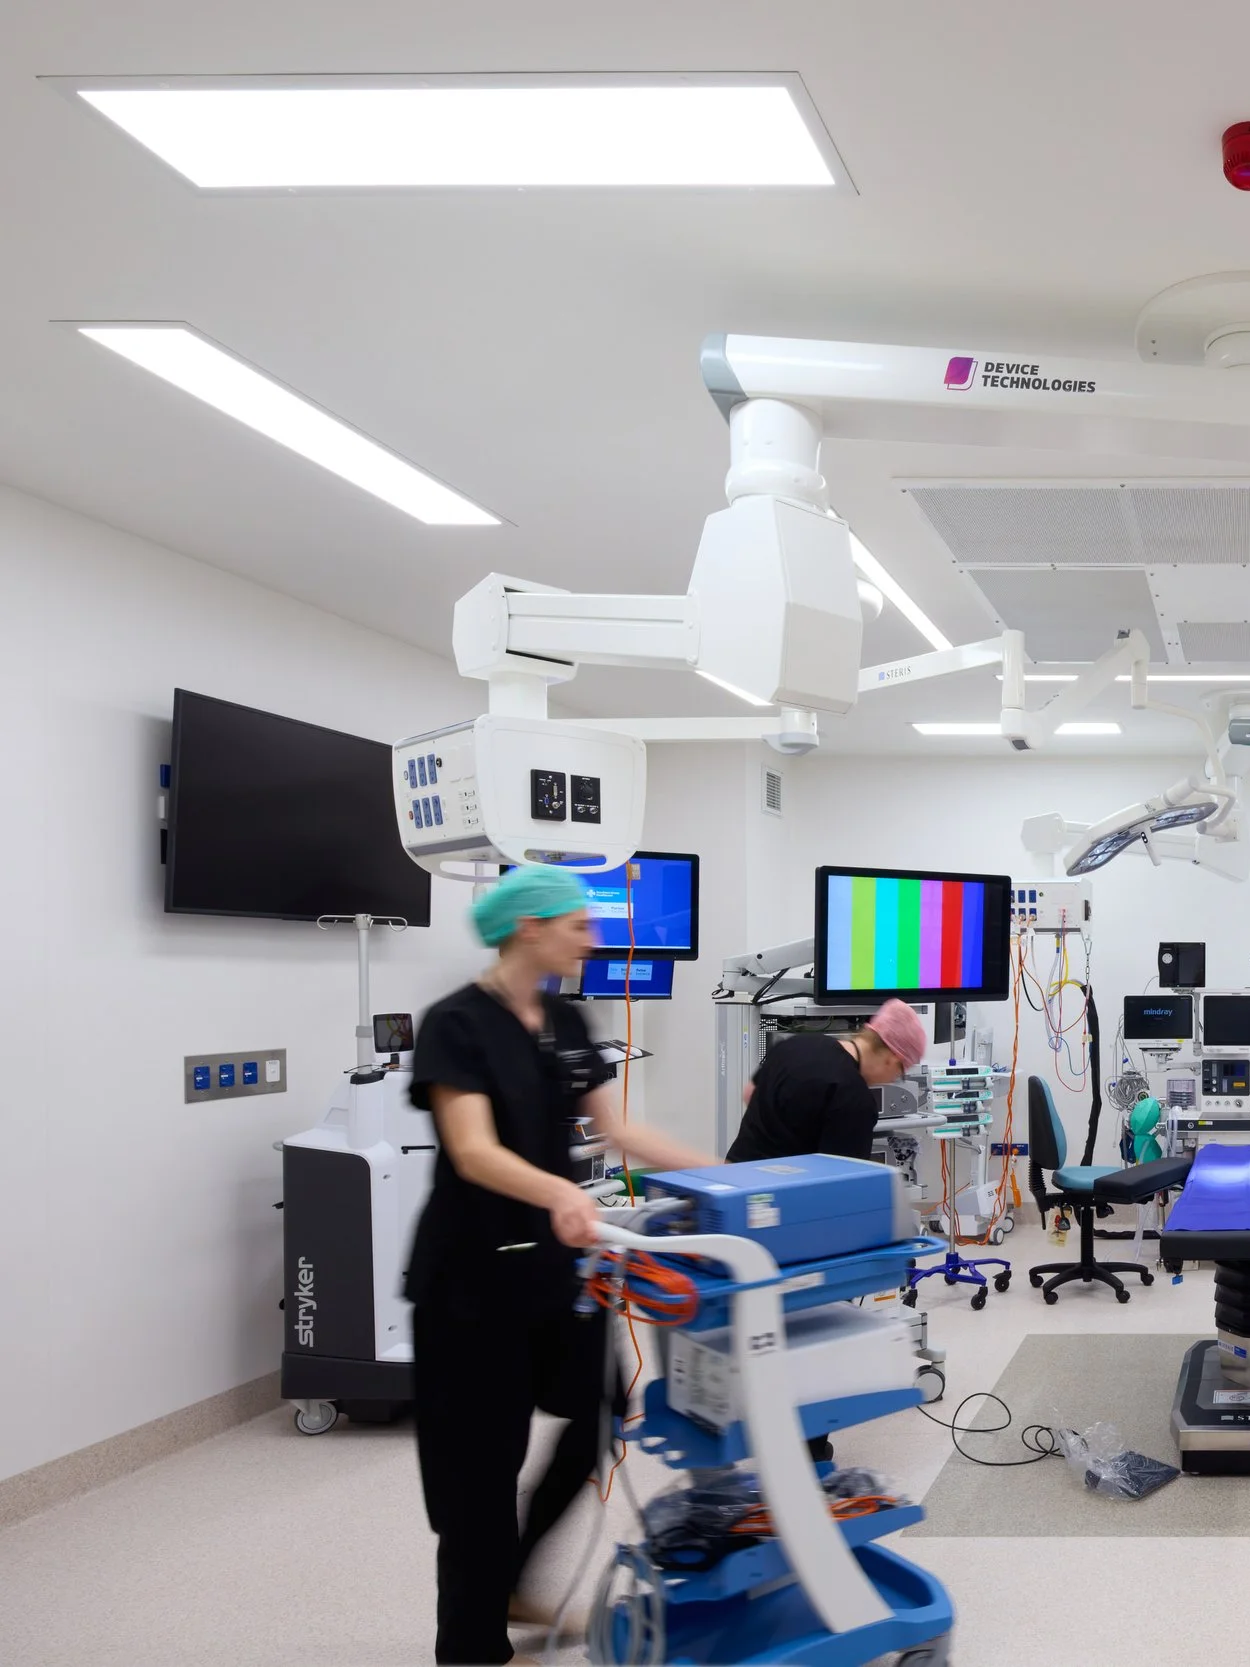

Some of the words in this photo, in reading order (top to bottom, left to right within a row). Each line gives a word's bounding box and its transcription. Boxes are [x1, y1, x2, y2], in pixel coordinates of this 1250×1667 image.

[984, 362, 1039, 375] DEVICE
[981, 375, 1096, 393] TECHNOLOGIES
[1143, 1008, 1173, 1016] mindray
[293, 1256, 317, 1348] stryker
